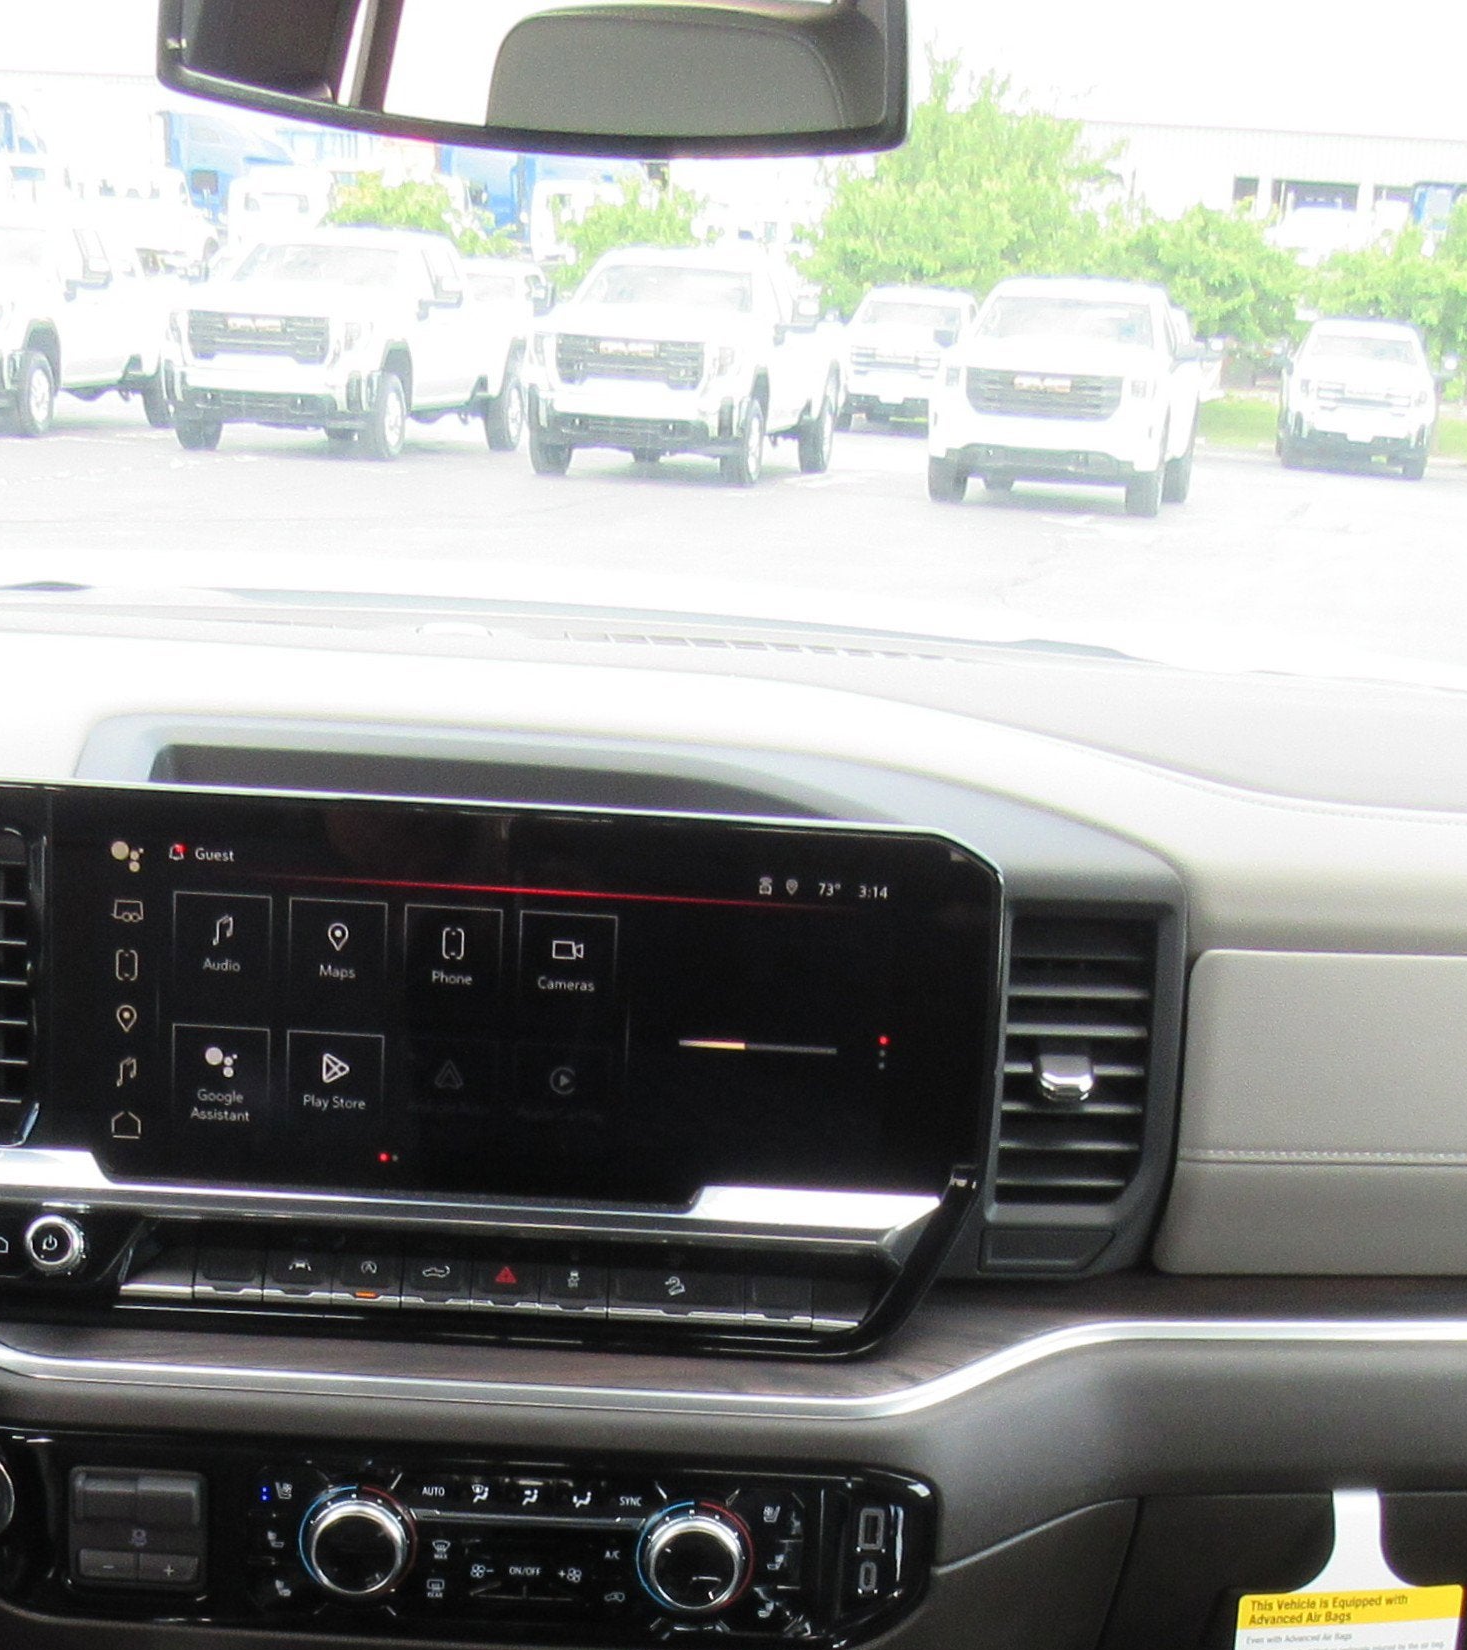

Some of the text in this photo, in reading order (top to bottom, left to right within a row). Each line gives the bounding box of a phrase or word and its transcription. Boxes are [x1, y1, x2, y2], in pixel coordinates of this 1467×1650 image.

[195, 847, 235, 862] Guest
[818, 881, 888, 899] 73° 3:14
[202, 957, 241, 973] Audio
[318, 963, 356, 980] Maps
[431, 969, 473, 985] Phone
[537, 975, 595, 992] Cameras
[197, 1088, 244, 1106] Google
[303, 1094, 366, 1112] Play Store
[190, 1106, 251, 1122] Assistant
[422, 1486, 446, 1497] AUTO
[619, 1496, 642, 1507] SYNC
[604, 1550, 620, 1560] A/C
[508, 1566, 541, 1576] ON/OFF
[1250, 1594, 1408, 1612] This Vehicle is Equipped with
[1248, 1609, 1352, 1626] Advanced Air Bags
